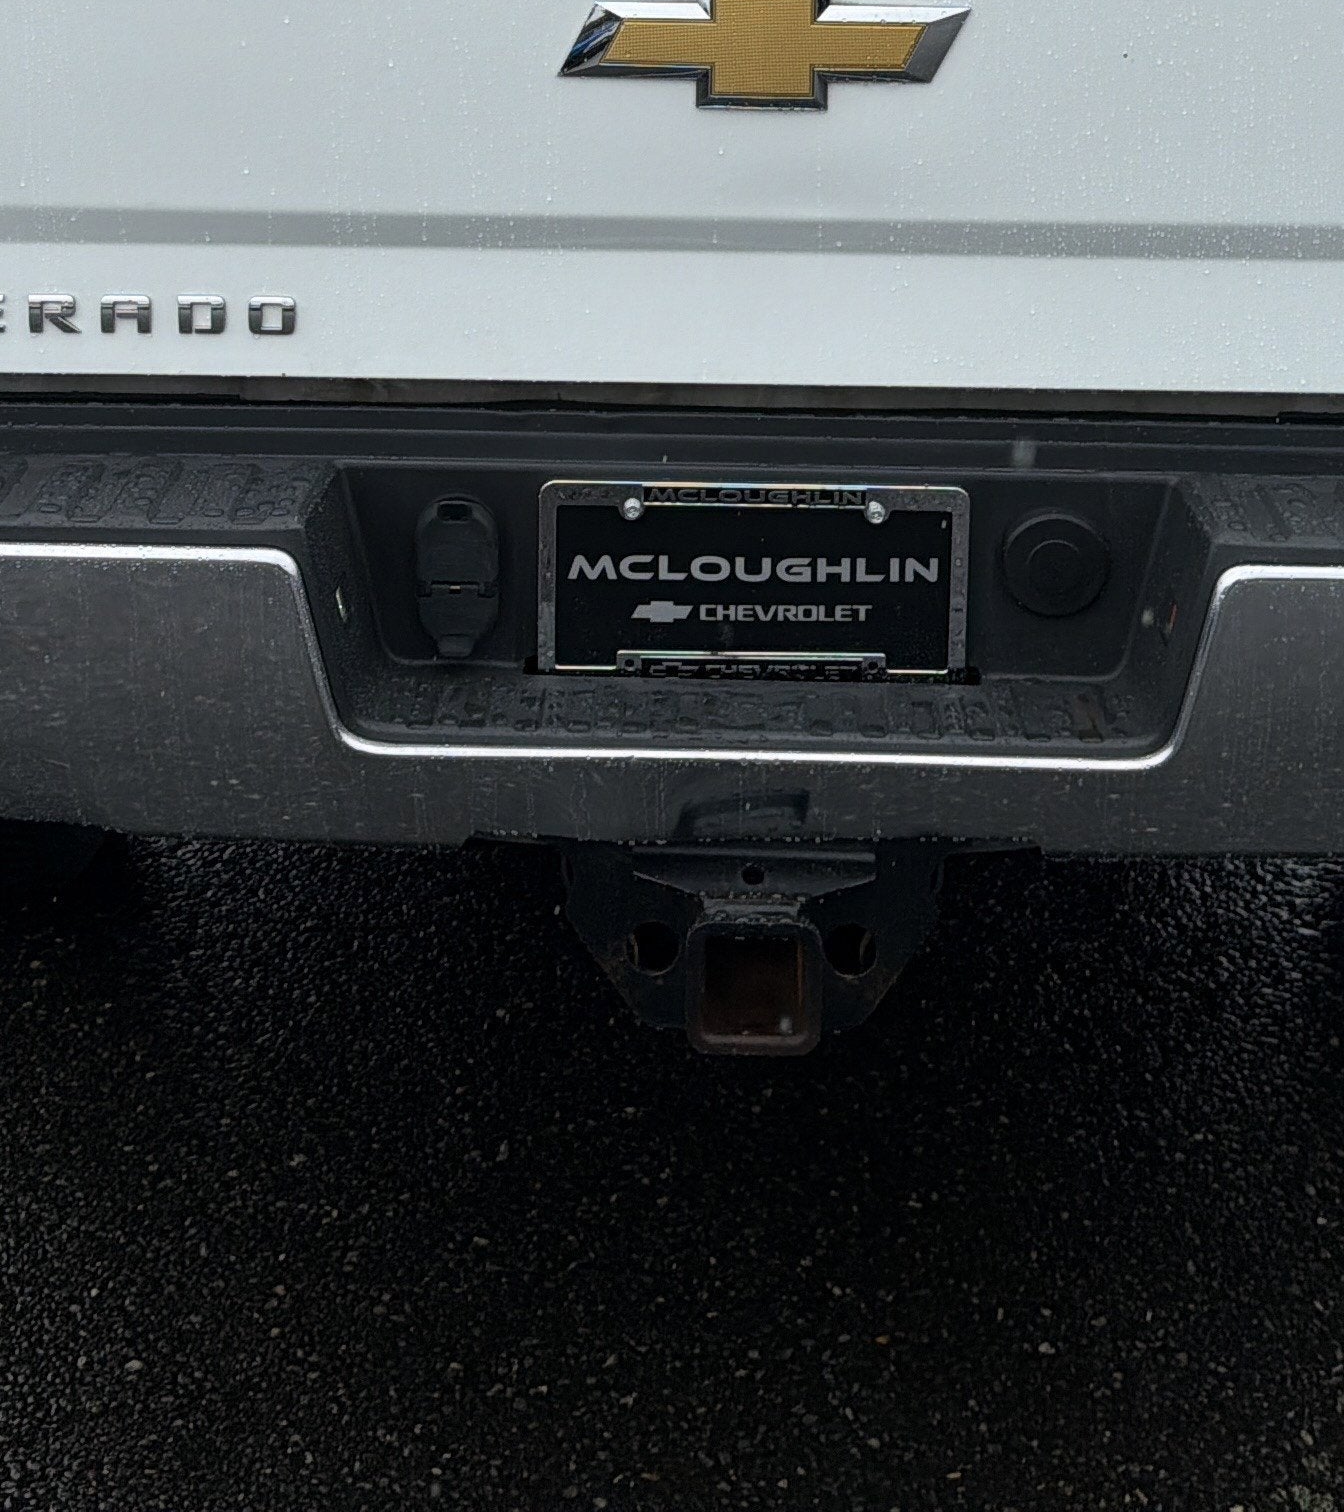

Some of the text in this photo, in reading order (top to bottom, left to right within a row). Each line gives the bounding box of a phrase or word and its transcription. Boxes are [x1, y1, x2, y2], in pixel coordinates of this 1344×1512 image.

[649, 488, 866, 505] MCLOUGHLIN
[567, 555, 939, 583] MCLOUGHLIN
[699, 604, 872, 622] CHEVROLET
